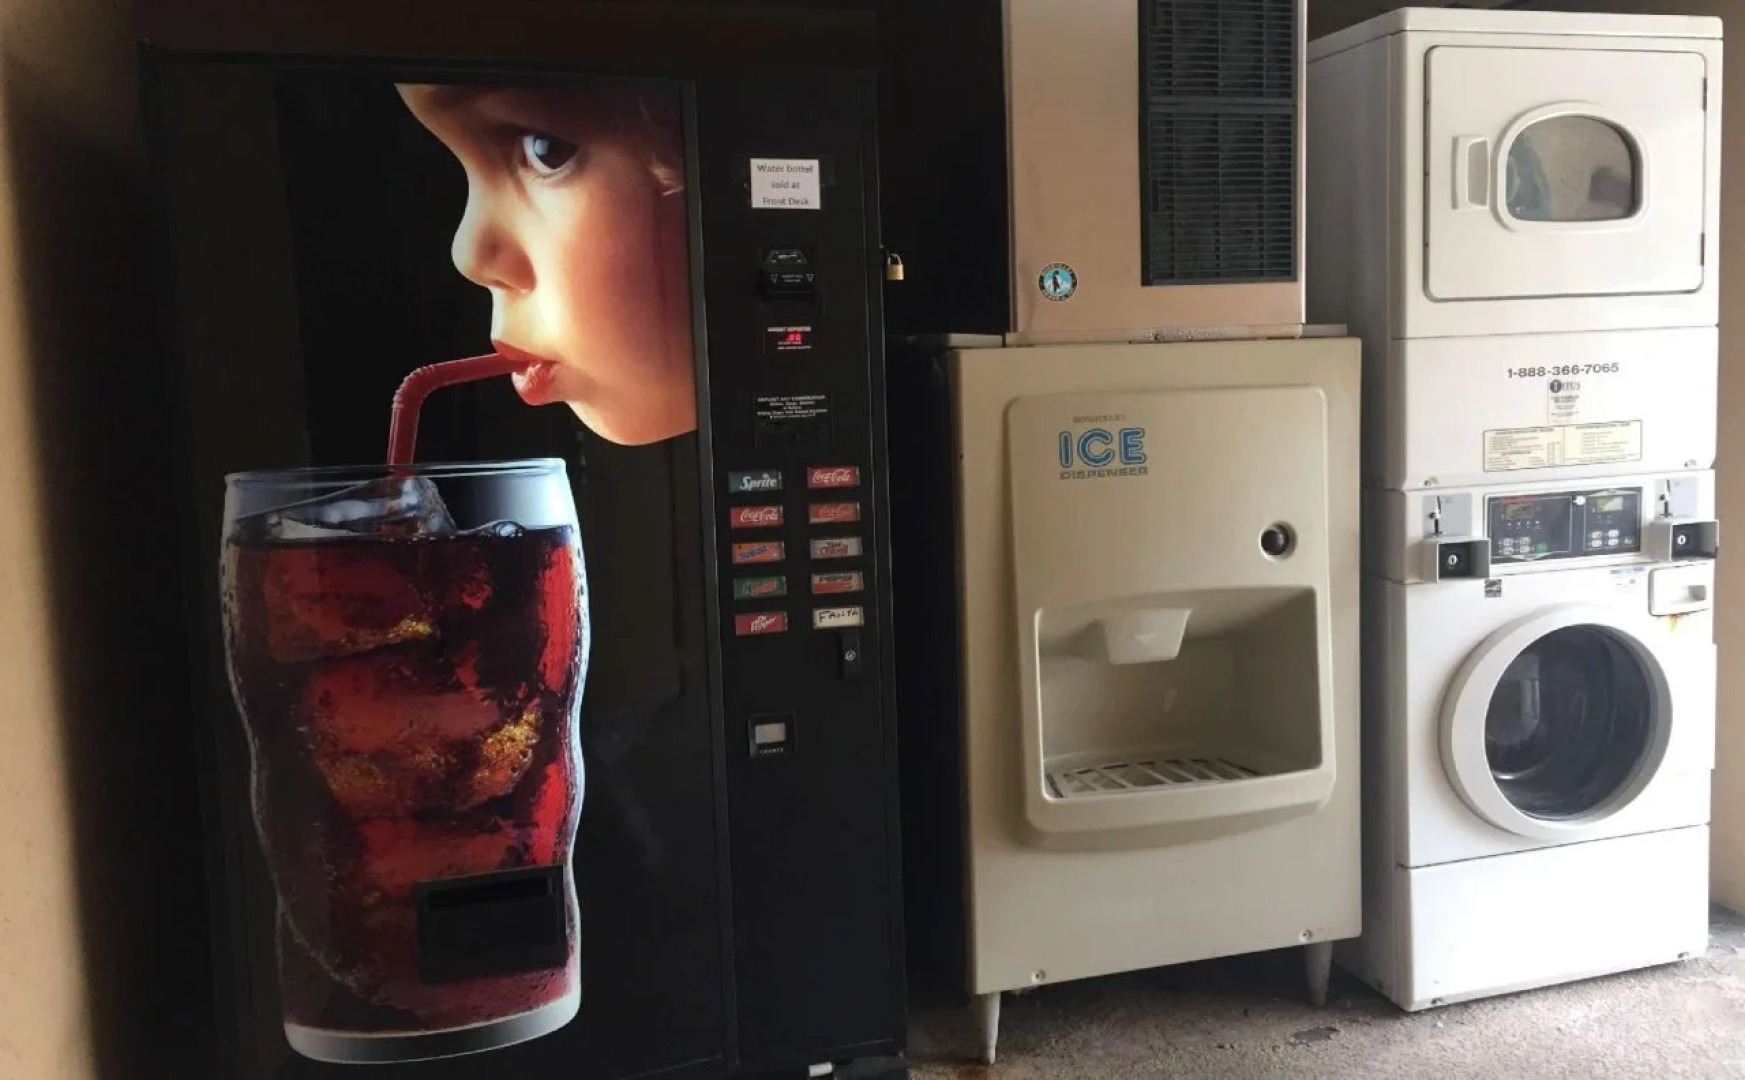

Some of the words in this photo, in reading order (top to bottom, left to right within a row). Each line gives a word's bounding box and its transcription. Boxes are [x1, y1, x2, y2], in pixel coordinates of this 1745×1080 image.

[757, 164, 784, 173] Water
[771, 181, 789, 189] sold
[791, 181, 801, 189] at
[763, 197, 786, 206] Front
[788, 197, 810, 206] Desk
[1507, 362, 1619, 379] 1-888-366-7065
[1058, 427, 1147, 469] ICE
[1059, 466, 1149, 480] DISPENSER
[740, 473, 777, 491] Sprite
